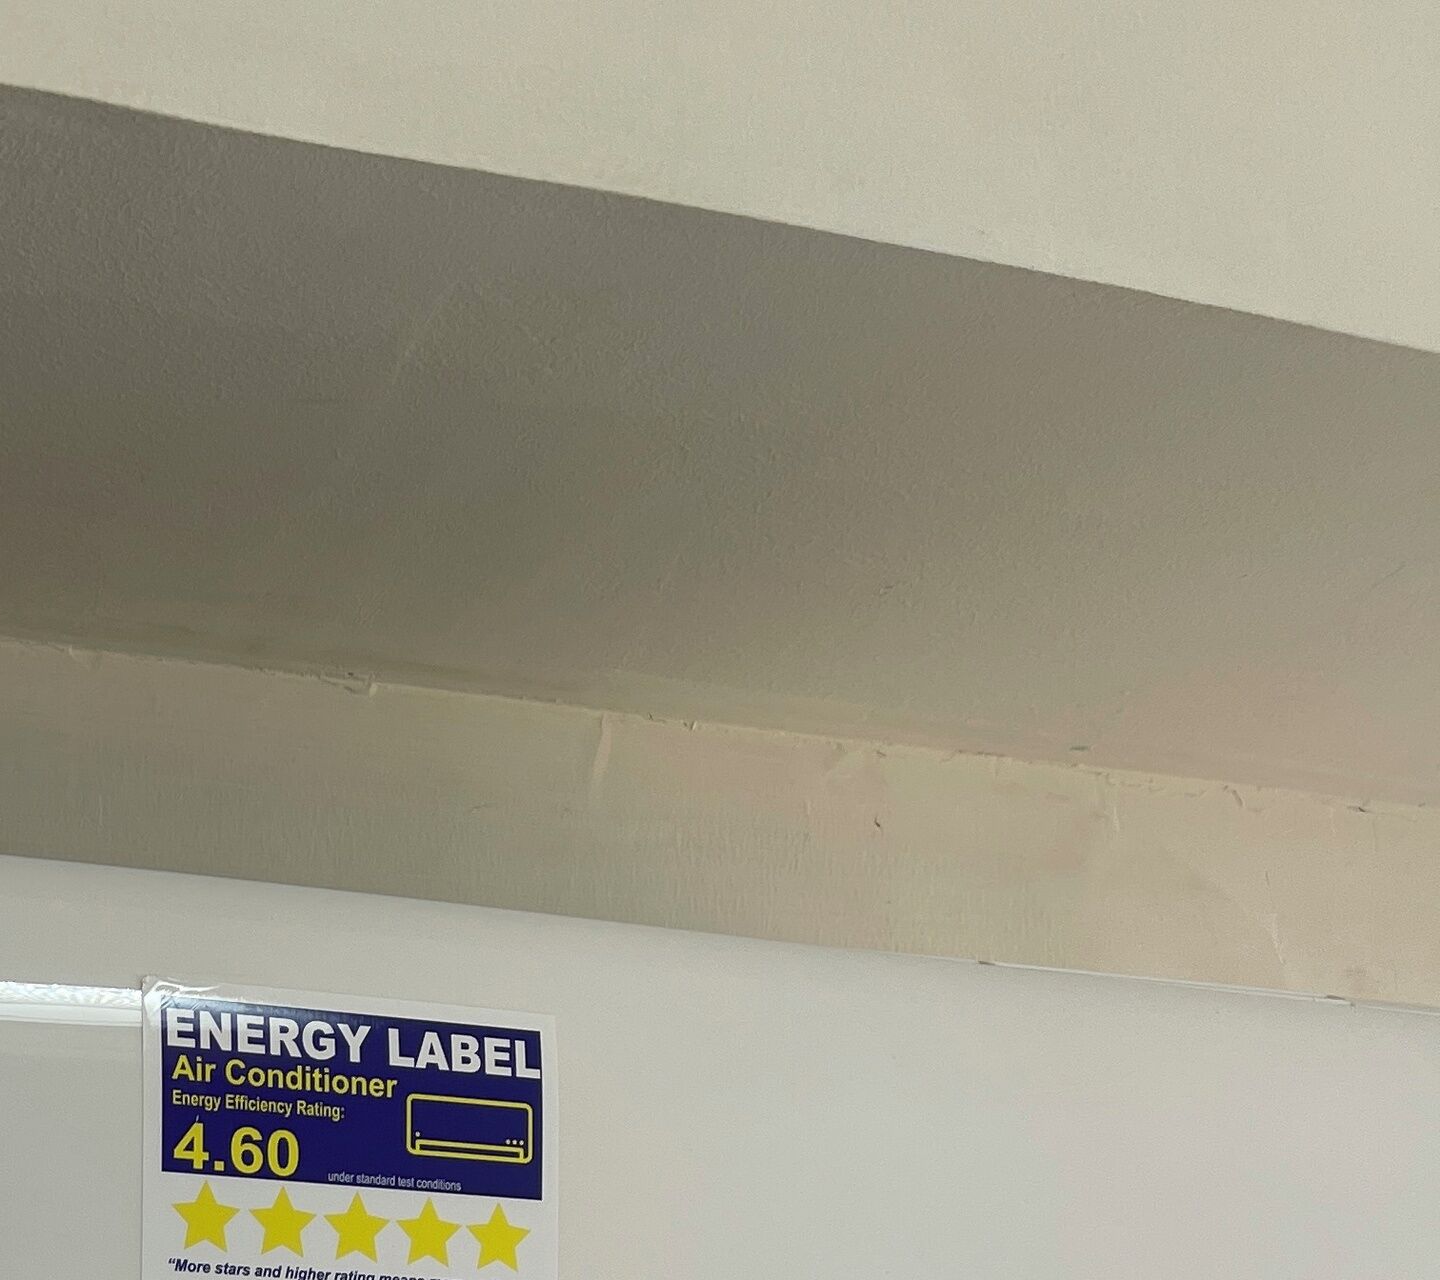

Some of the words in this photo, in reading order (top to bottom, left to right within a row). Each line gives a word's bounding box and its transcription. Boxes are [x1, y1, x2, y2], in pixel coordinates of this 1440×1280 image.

[166, 1008, 372, 1063] ENERGY
[387, 1028, 541, 1079] LABEL
[171, 1055, 216, 1083] Air
[225, 1059, 398, 1098] Conditioner
[172, 1090, 222, 1111] Energy
[225, 1095, 292, 1117] Efficiency
[297, 1100, 345, 1121] Rating:
[173, 1120, 300, 1177] 4.60
[327, 1170, 354, 1184] under
[356, 1173, 396, 1187] standard
[398, 1175, 415, 1188] test
[416, 1177, 462, 1192] conditions
[215, 1262, 250, 1276] stars
[254, 1266, 282, 1278] and
